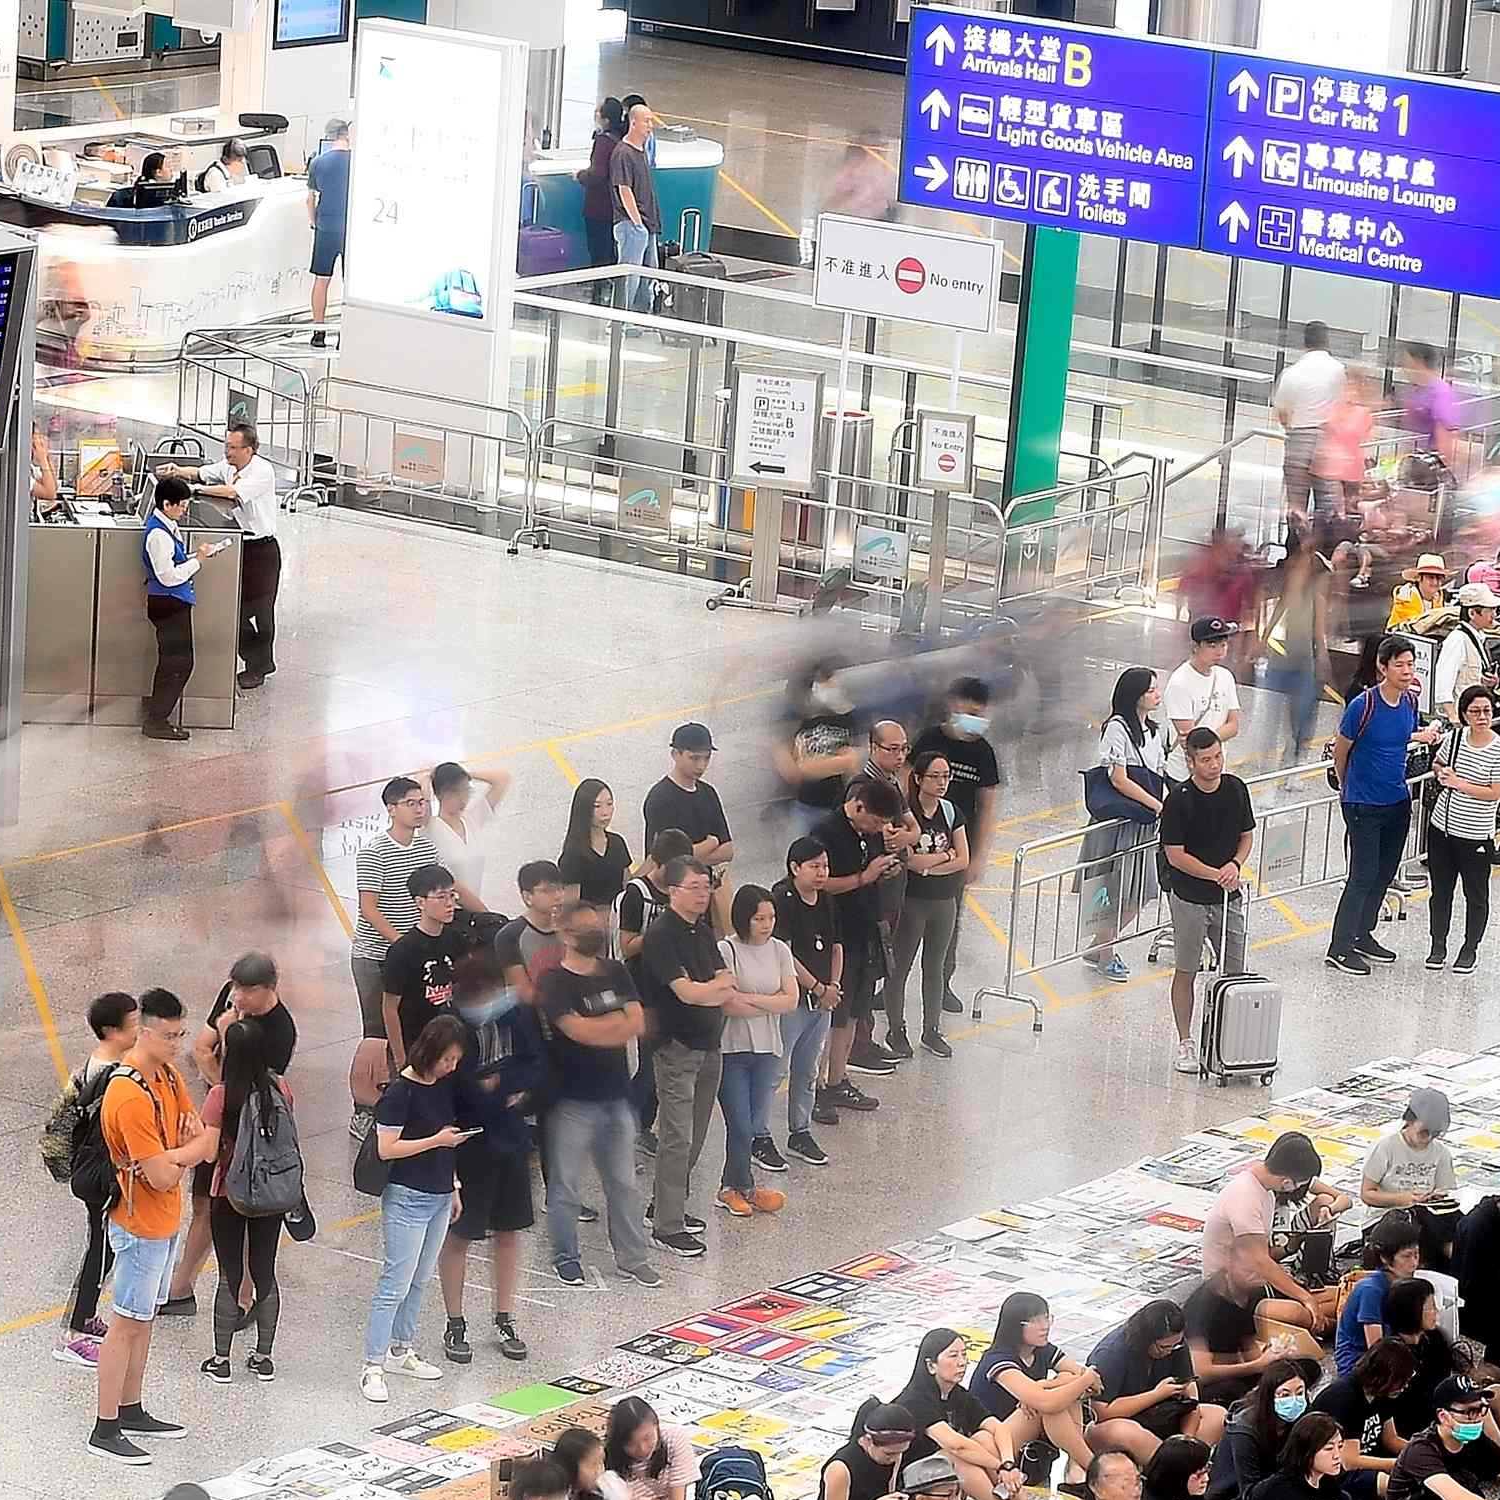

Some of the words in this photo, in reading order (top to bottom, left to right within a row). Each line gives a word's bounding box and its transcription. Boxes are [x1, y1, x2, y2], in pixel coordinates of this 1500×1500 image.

[963, 24, 1062, 63] 接機大堂
[962, 53, 1024, 79] Arrivals
[1025, 61, 1057, 84] Hall
[1064, 42, 1093, 87] B
[1311, 76, 1388, 112] 停車場
[999, 95, 1124, 138] 輕型貨車區
[1308, 105, 1339, 127] Car
[1341, 111, 1380, 133] Park
[1393, 94, 1410, 136] 1
[997, 122, 1038, 148] Light
[1040, 130, 1094, 156] Goods
[1095, 138, 1152, 164] Vehicle
[1154, 147, 1194, 171] Area
[1077, 172, 1152, 209] 洗手間
[1302, 170, 1389, 202] Limousine
[1393, 185, 1457, 214] Lounge
[372, 198, 399, 225] 24
[1075, 200, 1127, 226] Toilets
[1301, 207, 1404, 247] 醫療中心
[824, 256, 890, 281] 不准進入
[1299, 238, 1364, 264] Medical
[1367, 247, 1423, 273] Centre
[930, 272, 948, 287] No
[952, 276, 984, 295] entry
[786, 417, 794, 428] B
[931, 440, 942, 449] No
[943, 441, 965, 453] Entry
